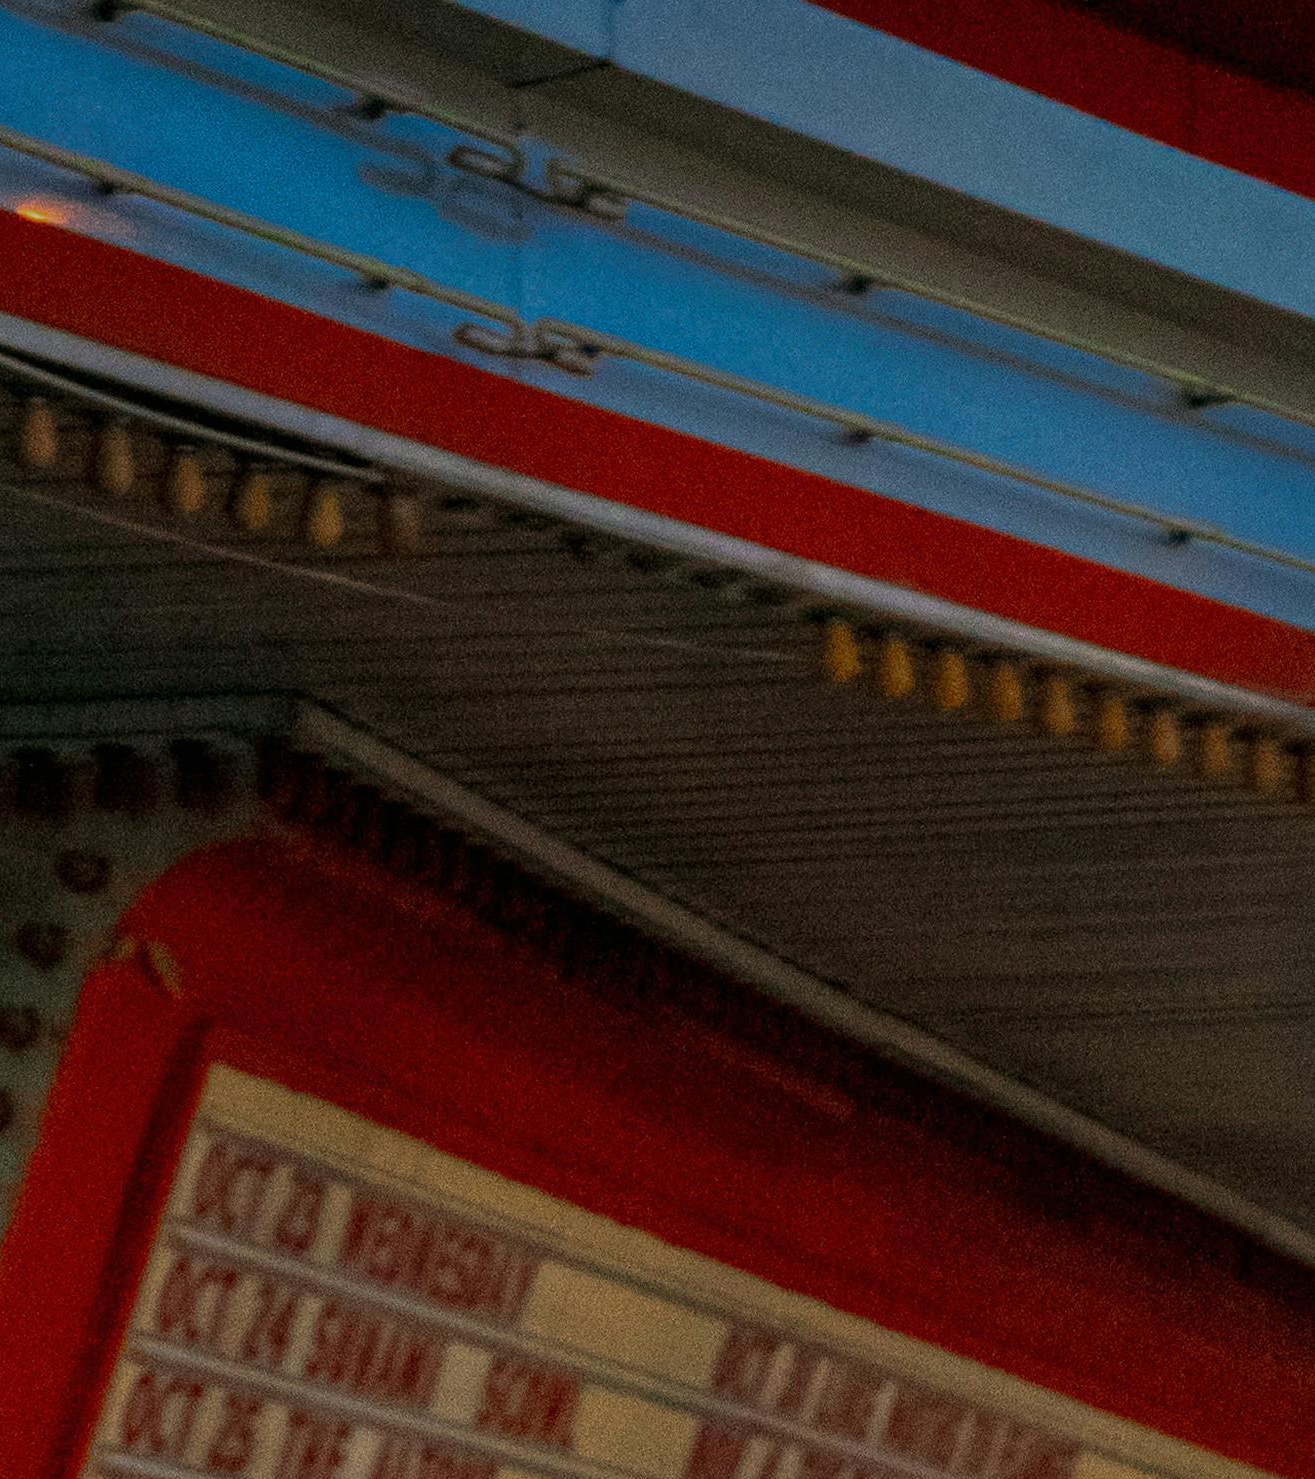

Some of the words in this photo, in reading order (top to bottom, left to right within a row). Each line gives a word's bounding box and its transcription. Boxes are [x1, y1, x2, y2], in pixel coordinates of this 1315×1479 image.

[183, 1136, 275, 1238] OCT
[148, 1252, 240, 1349] OCT
[111, 1367, 207, 1464] OCT
